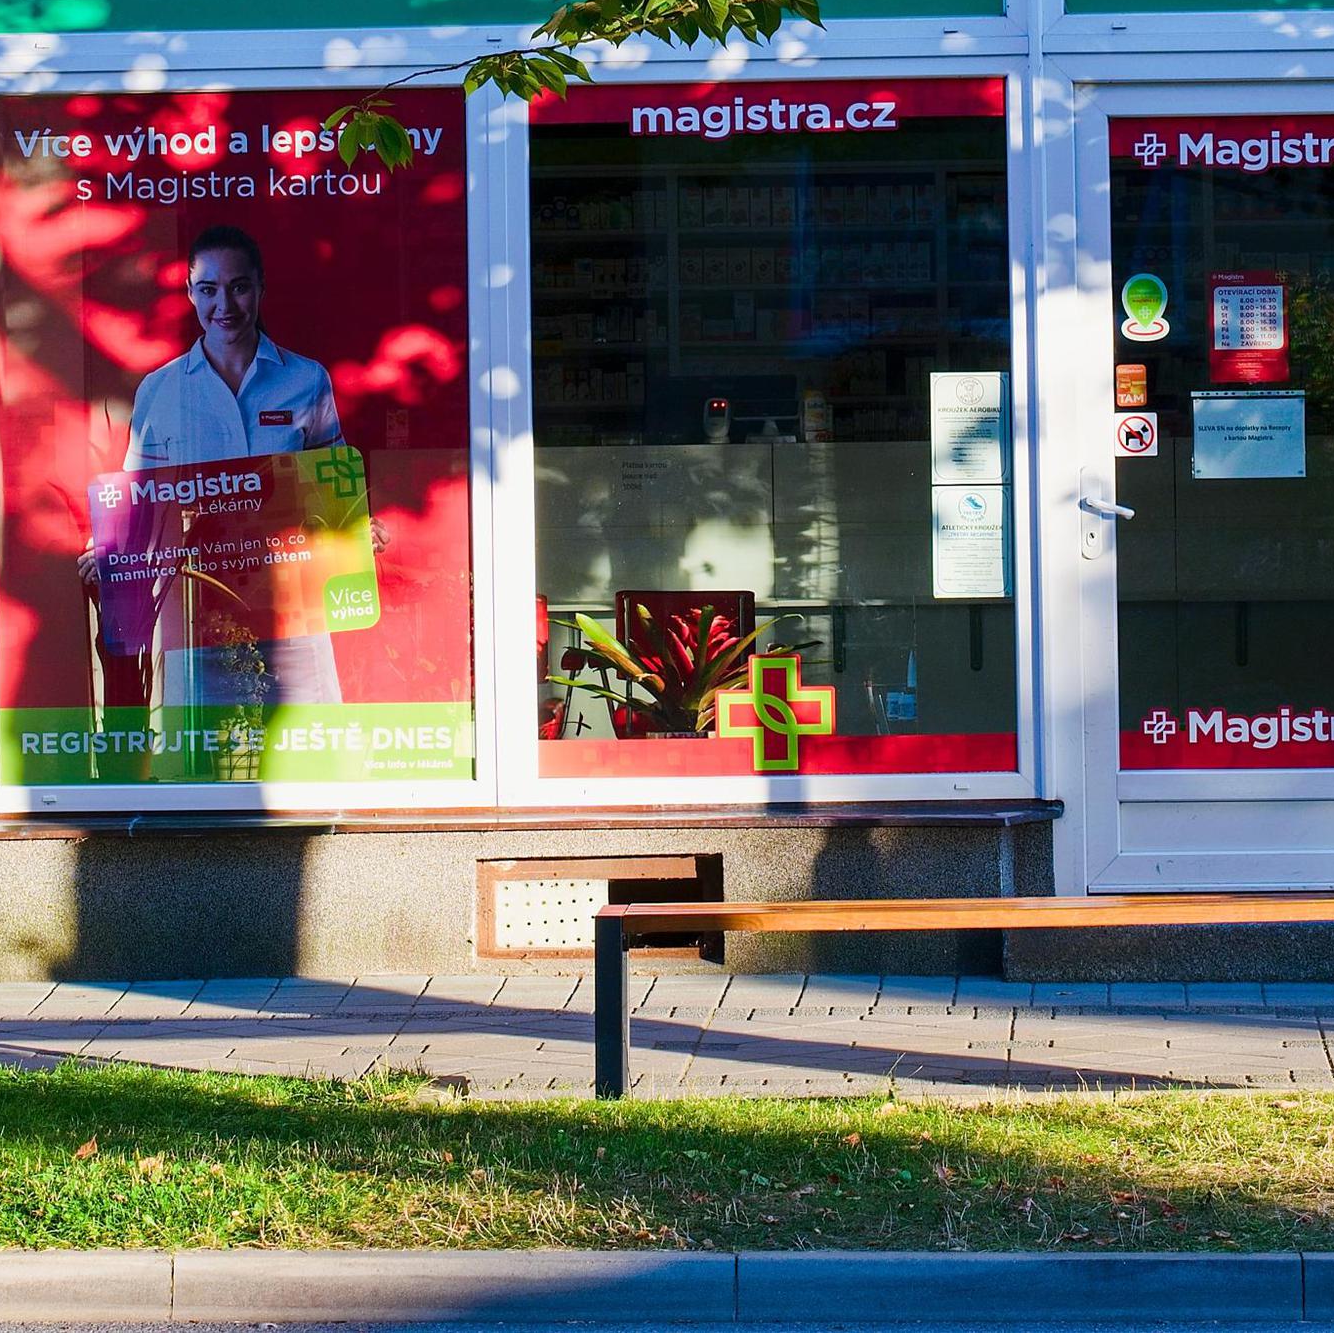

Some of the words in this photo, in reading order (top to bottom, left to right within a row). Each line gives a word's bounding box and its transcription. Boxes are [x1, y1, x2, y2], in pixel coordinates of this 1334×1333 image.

[632, 96, 897, 137] magistra.cz
[15, 127, 92, 158] Více
[105, 125, 216, 161] výhod
[229, 132, 248, 154] a
[76, 177, 92, 201] s
[106, 171, 256, 204] Magistra
[269, 168, 382, 196] kartou
[1119, 394, 1144, 403] TAM
[130, 470, 262, 507] Magistra
[198, 495, 263, 516] Lékárny
[108, 544, 200, 567] Doporučíme
[203, 540, 236, 555] Vám
[238, 536, 261, 555] jen
[266, 534, 285, 550] to,
[288, 533, 306, 546] co
[110, 563, 177, 583] mamince
[181, 560, 219, 576] nebo
[221, 554, 261, 572] svým
[264, 548, 312, 566] dětem
[329, 587, 373, 605] Více
[331, 602, 374, 620] výhod
[22, 729, 219, 755] REGISTRUJTE
[230, 728, 265, 752] SE
[275, 721, 360, 752] JEŠTĚ
[372, 726, 453, 750] DNES
